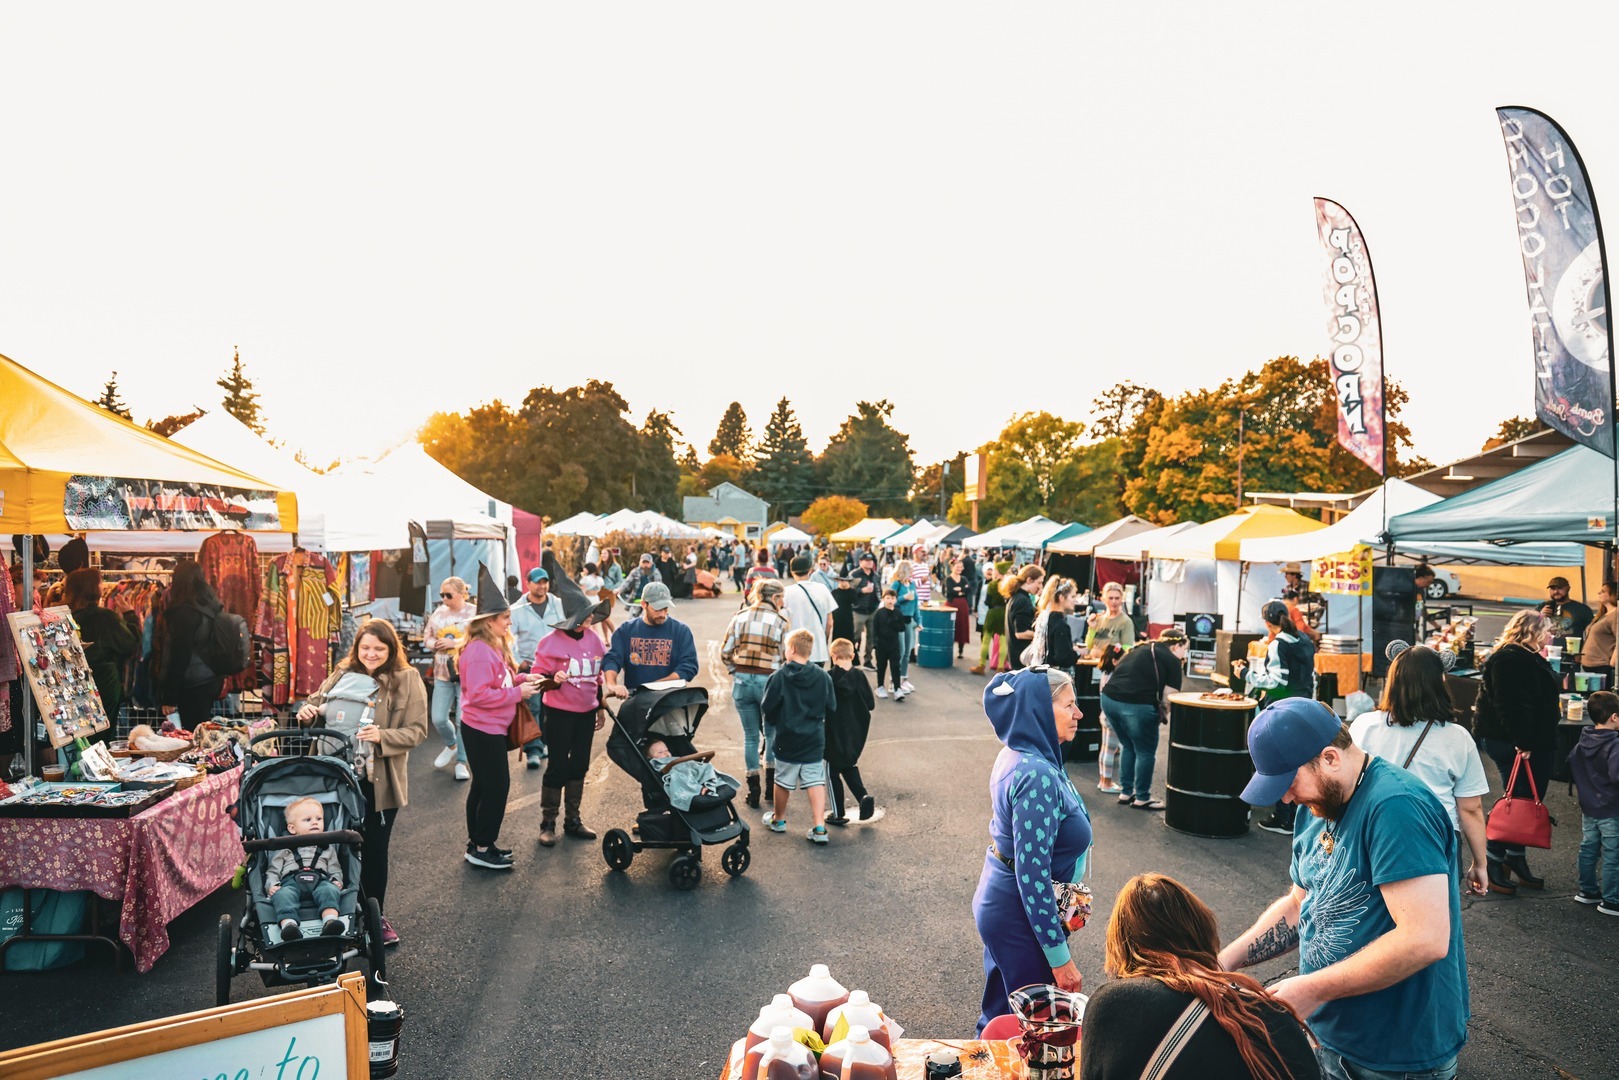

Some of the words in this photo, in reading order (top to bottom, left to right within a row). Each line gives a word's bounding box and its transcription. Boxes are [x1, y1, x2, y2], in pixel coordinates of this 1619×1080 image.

[1319, 561, 1361, 580] PIES
[630, 637, 673, 653] WESTERN
[275, 1036, 321, 1080] to
